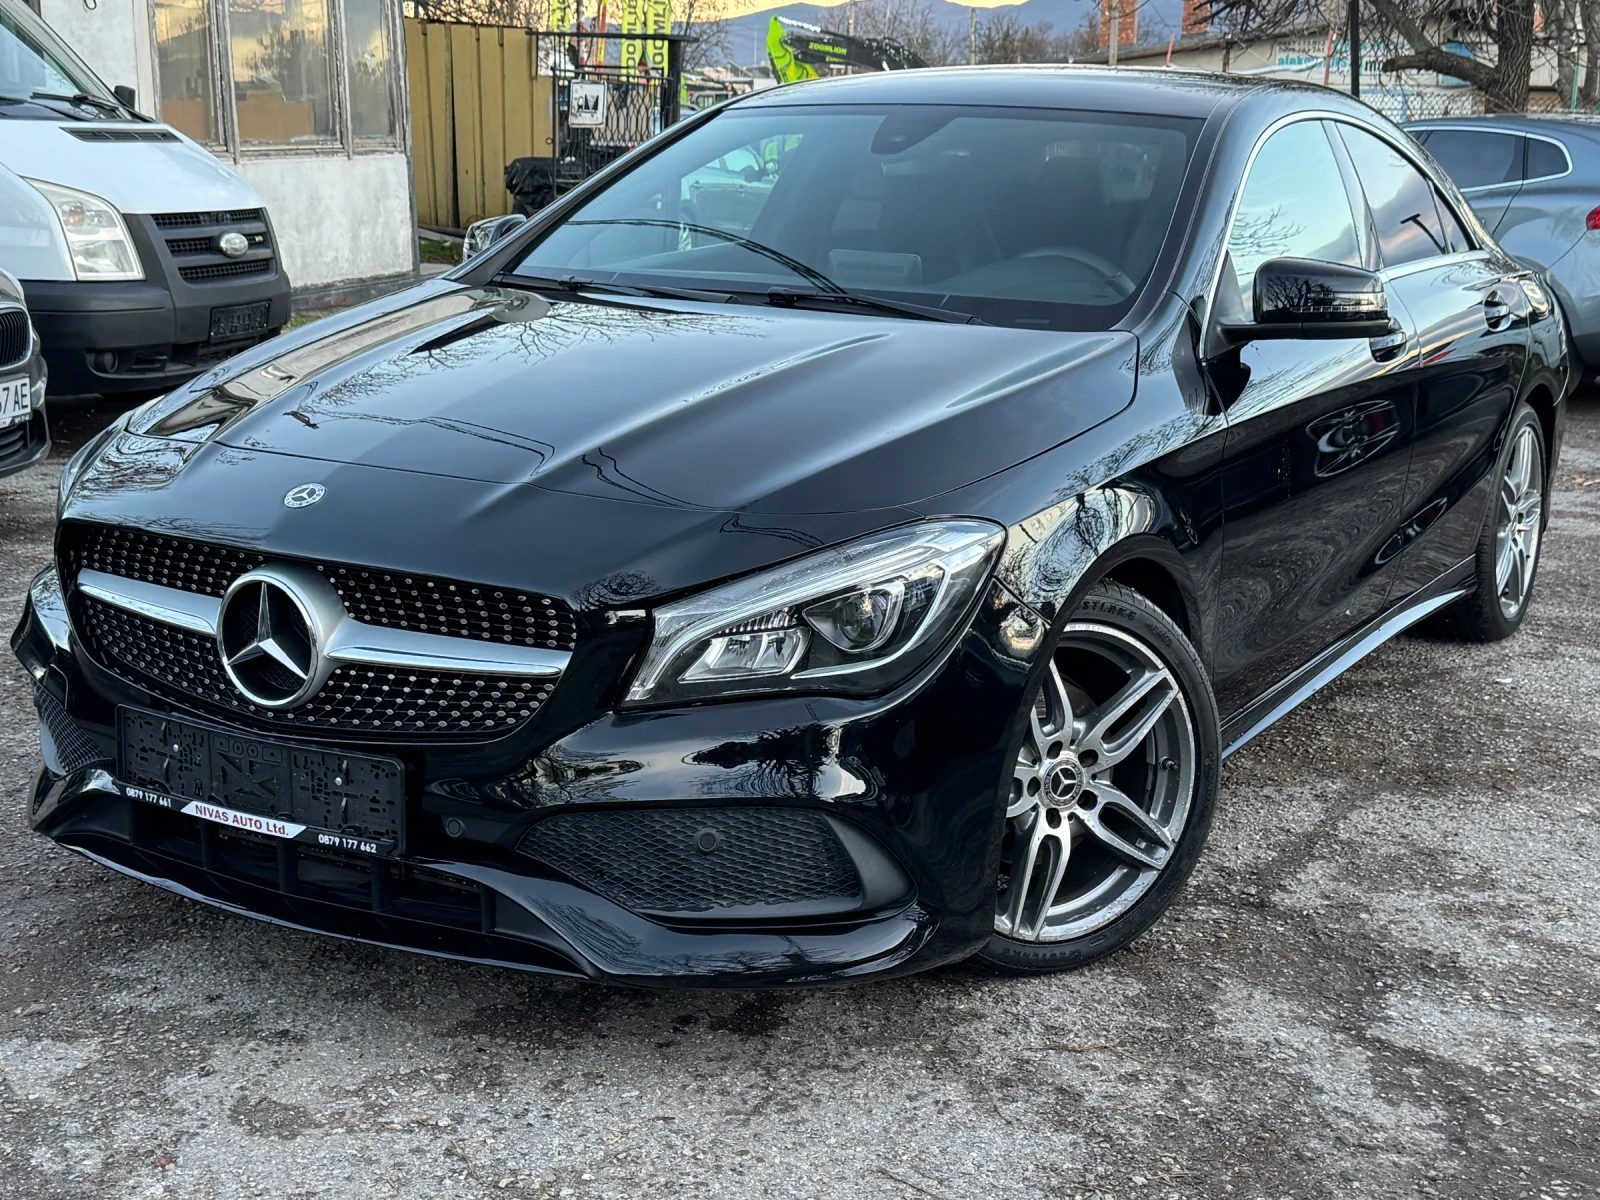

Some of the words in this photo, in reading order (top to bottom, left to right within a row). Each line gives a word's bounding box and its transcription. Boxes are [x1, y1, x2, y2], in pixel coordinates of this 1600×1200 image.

[808, 41, 848, 56] ZOOMLION
[0, 386, 10, 415] 7
[125, 787, 143, 800] 0879
[144, 791, 158, 804] 177
[195, 804, 230, 822] NIVAS
[231, 813, 263, 830] AUTO
[266, 821, 289, 836] Ltd.
[318, 833, 340, 847] 0879
[342, 838, 358, 850] 177
[360, 841, 377, 854] 662
